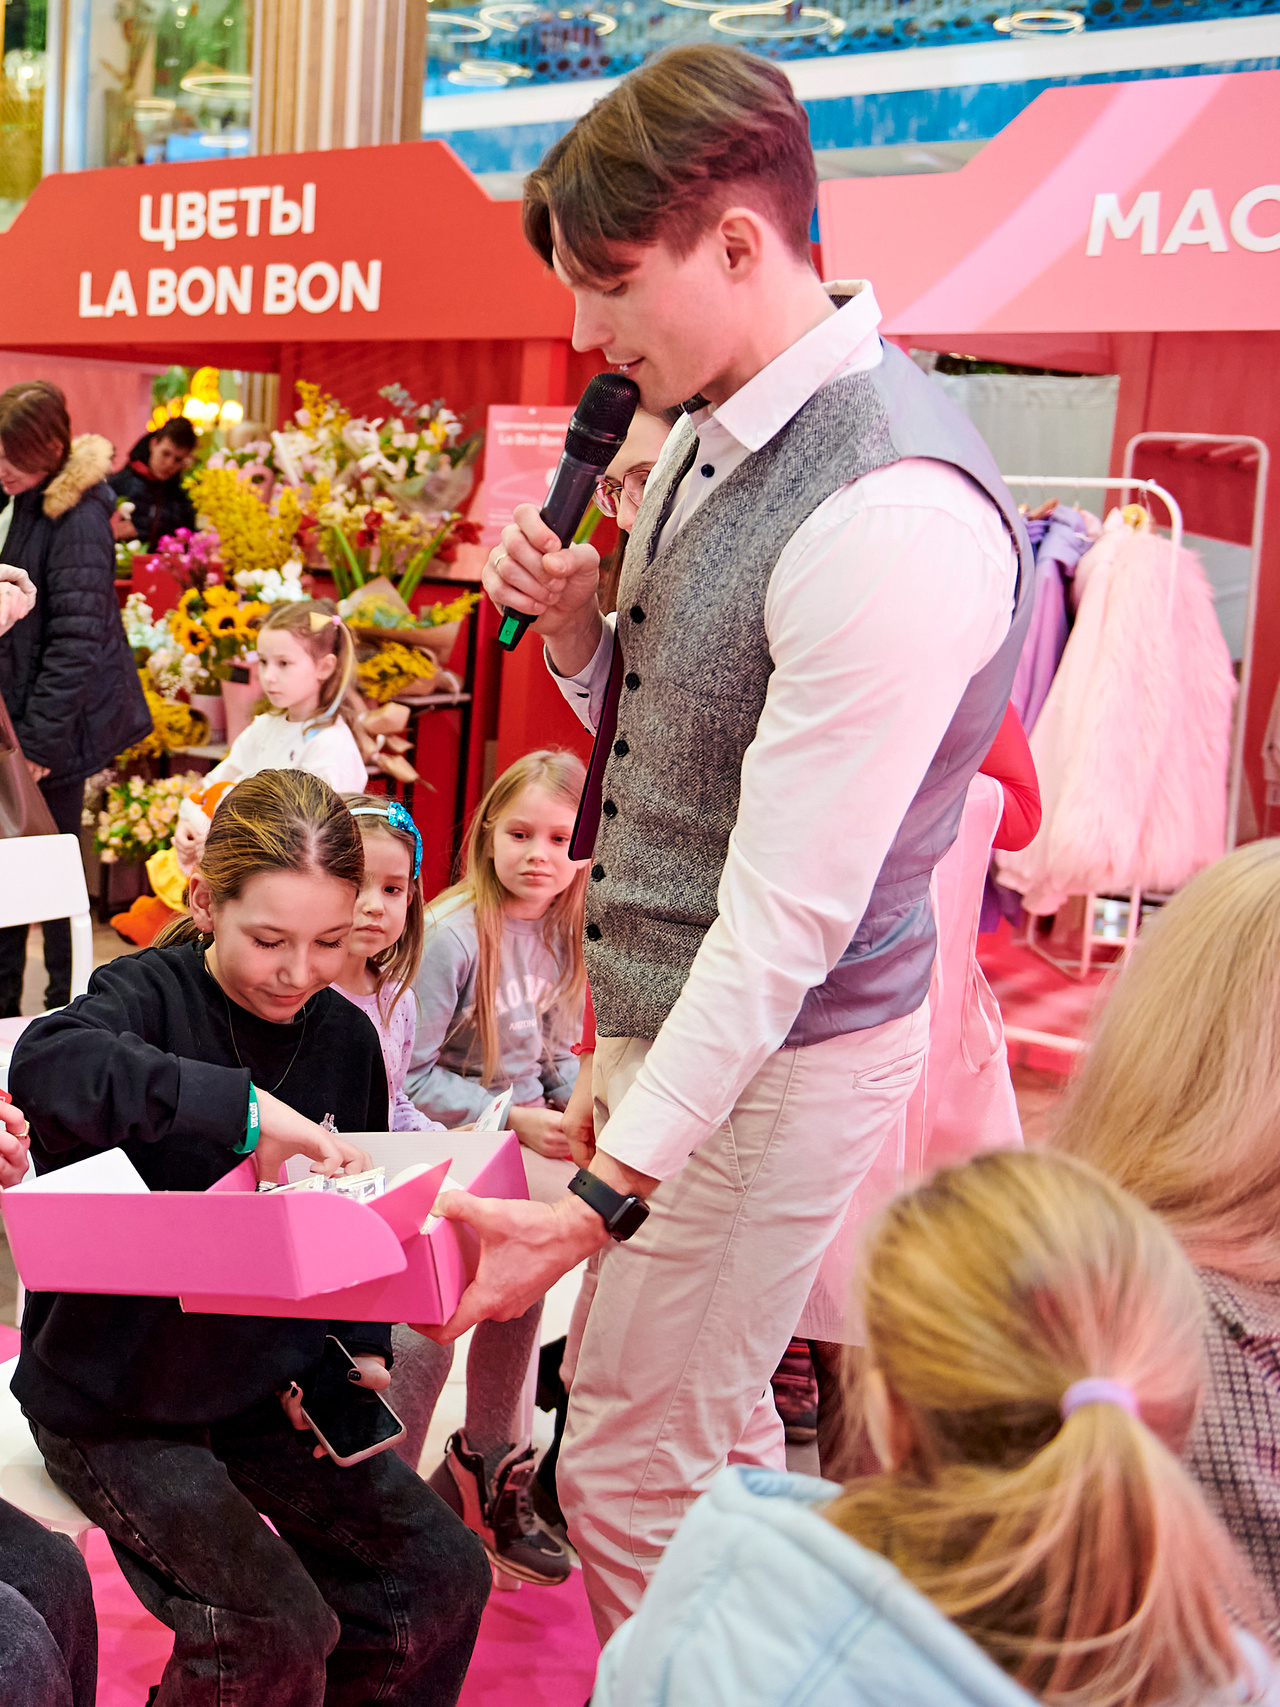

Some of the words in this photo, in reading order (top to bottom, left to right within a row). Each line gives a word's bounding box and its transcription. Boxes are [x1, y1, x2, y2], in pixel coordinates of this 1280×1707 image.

[139, 182, 316, 251] ЦВЕТЫ
[79, 270, 138, 318] LA
[146, 264, 253, 316] BON
[263, 259, 382, 315] BON
